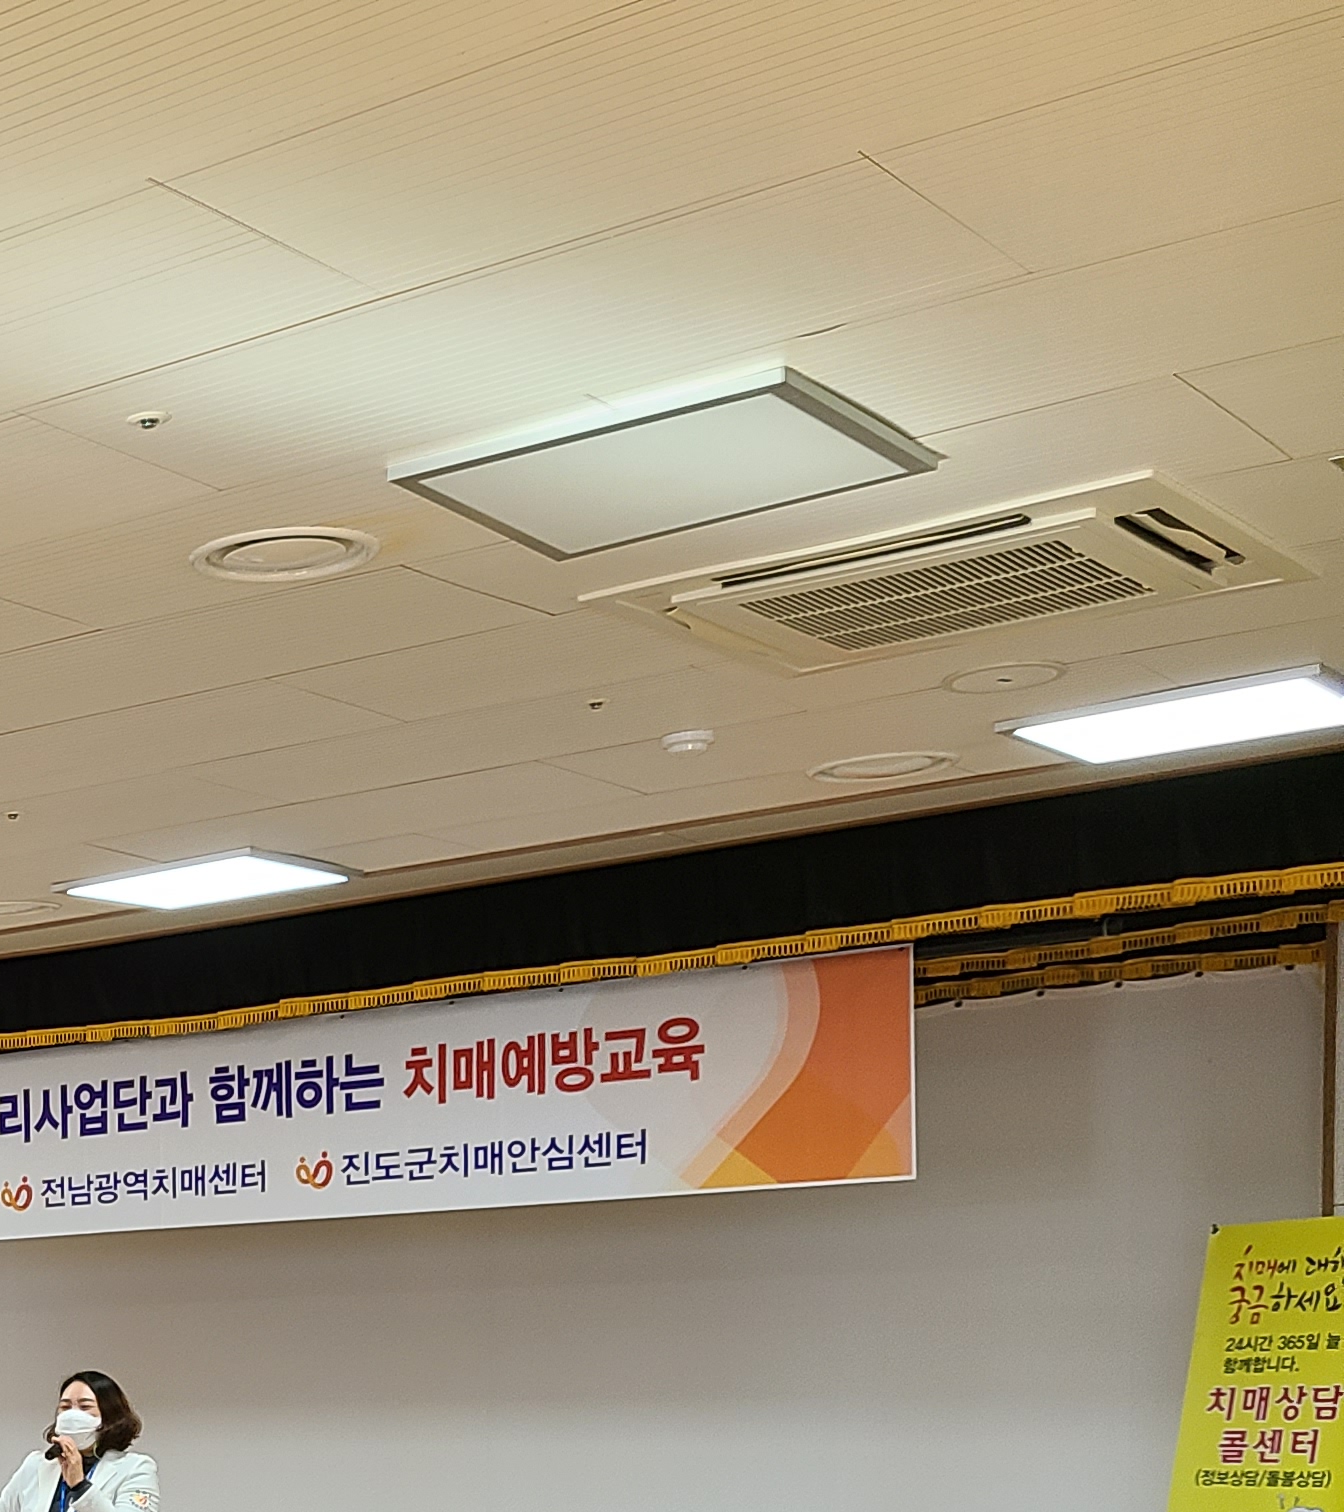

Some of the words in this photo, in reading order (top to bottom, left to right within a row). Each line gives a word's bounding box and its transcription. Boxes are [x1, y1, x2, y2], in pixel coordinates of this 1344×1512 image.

[208, 1053, 385, 1125] 함께하는
[402, 1015, 706, 1105] 치매예방교육
[40, 1158, 268, 1210] 전남광역치매센터
[340, 1128, 649, 1187] 진도군치매안심센터
[1225, 1335, 1274, 1352] 24시간
[1277, 1333, 1321, 1351] 365일
[1223, 1356, 1300, 1375] 함께합니다.
[1205, 1384, 1344, 1422] 치매상담
[1218, 1428, 1321, 1465] 콜센터
[1195, 1469, 1332, 1489] (정보상담/돌봄상담)
